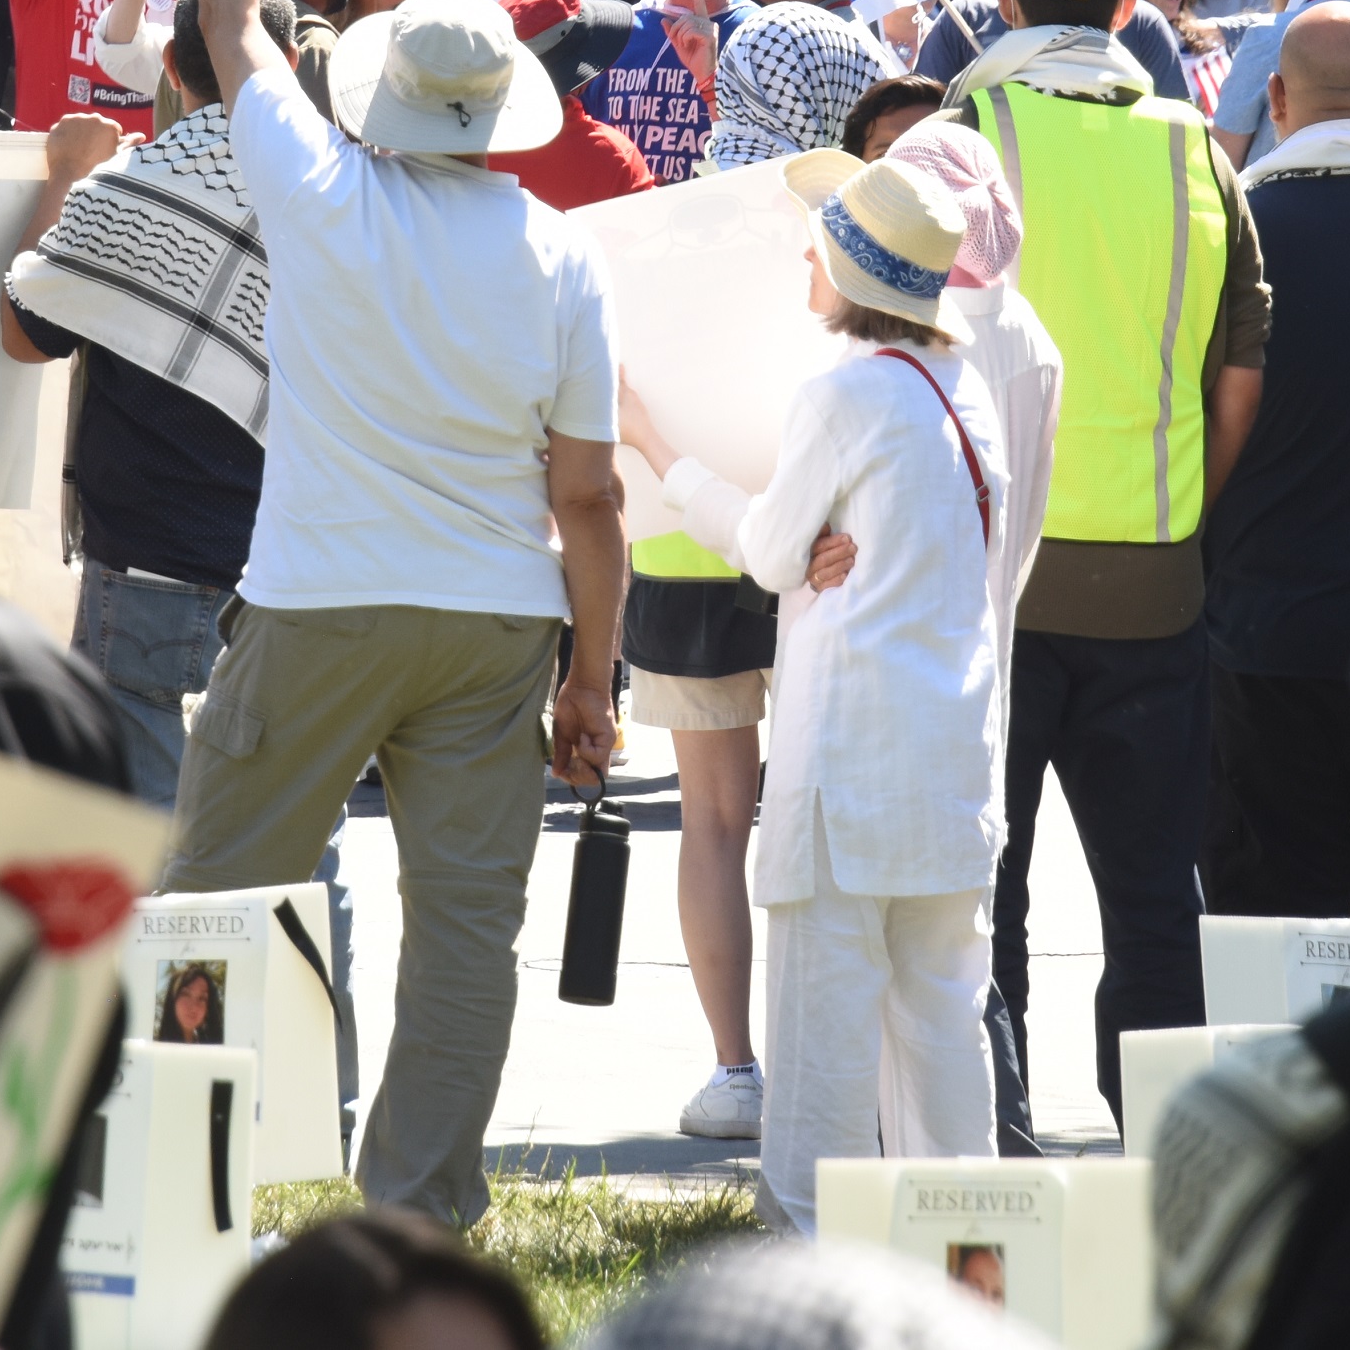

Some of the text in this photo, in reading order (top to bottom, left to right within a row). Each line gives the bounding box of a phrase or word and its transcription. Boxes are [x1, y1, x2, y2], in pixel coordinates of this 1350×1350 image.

[608, 68, 652, 93] FROM
[656, 68, 688, 94] THE
[607, 96, 624, 120] TO
[628, 95, 662, 121] THE
[663, 156, 685, 181] US
[143, 915, 245, 936] RESERVED
[917, 1189, 1035, 1212] RESERVED
